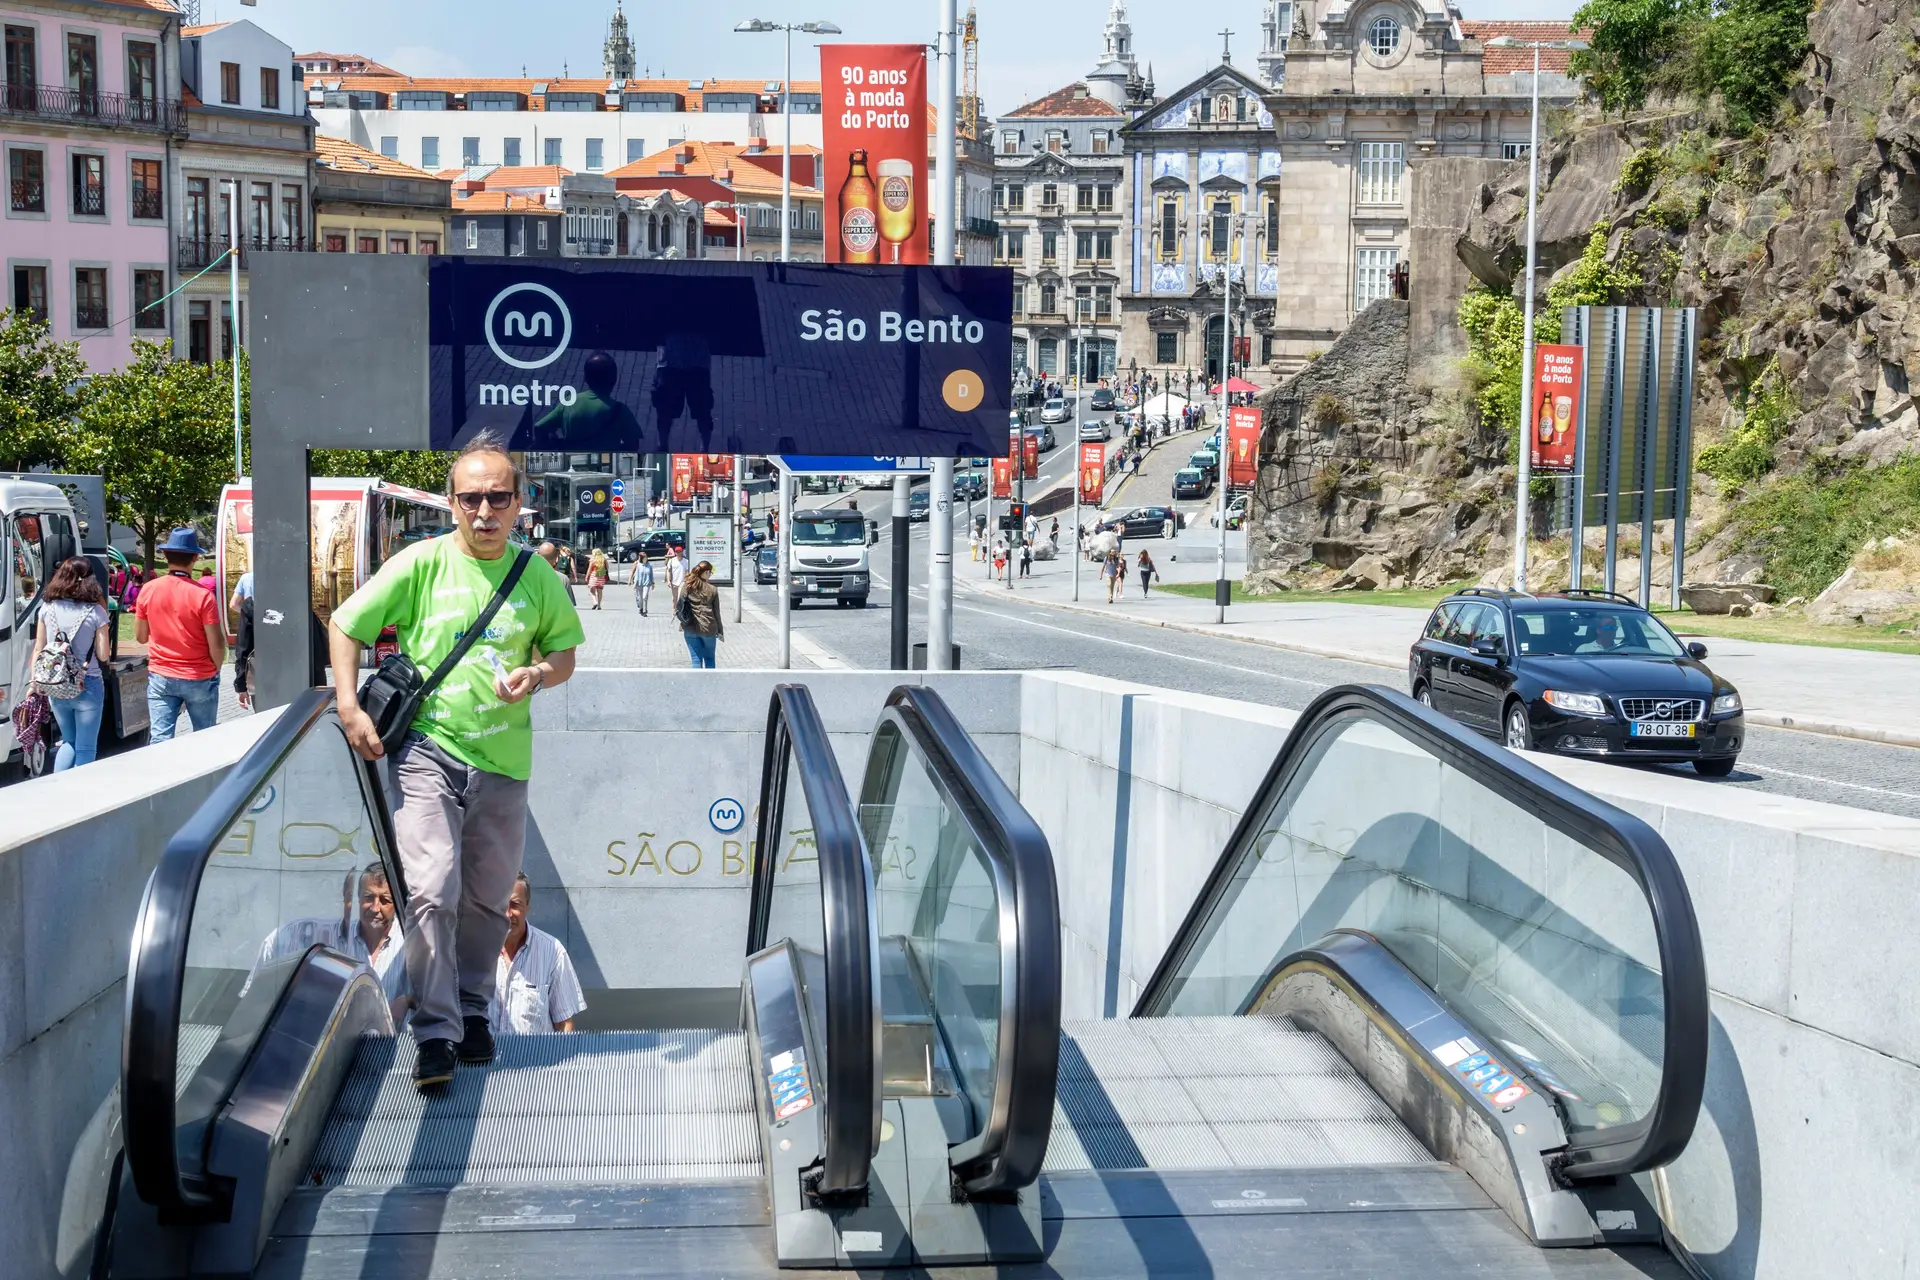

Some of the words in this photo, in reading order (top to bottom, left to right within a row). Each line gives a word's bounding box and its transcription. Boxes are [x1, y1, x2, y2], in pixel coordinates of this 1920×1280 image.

[841, 66, 864, 85] 90
[868, 69, 907, 85] anos
[845, 87, 855, 107] à
[860, 87, 905, 107] moda
[841, 109, 862, 129] do
[866, 109, 910, 129] Porto
[800, 308, 867, 342] São
[879, 311, 984, 344] Bento
[1543, 354, 1554, 363] 90
[1555, 356, 1574, 364] anos
[1544, 363, 1550, 373] à
[1550, 364, 1572, 374] moda
[1541, 373, 1551, 383] do
[1552, 374, 1573, 384] Porto
[480, 379, 577, 407] metro
[958, 384, 968, 397] D
[612, 500, 624, 508] STOP
[607, 832, 703, 876] SÃO
